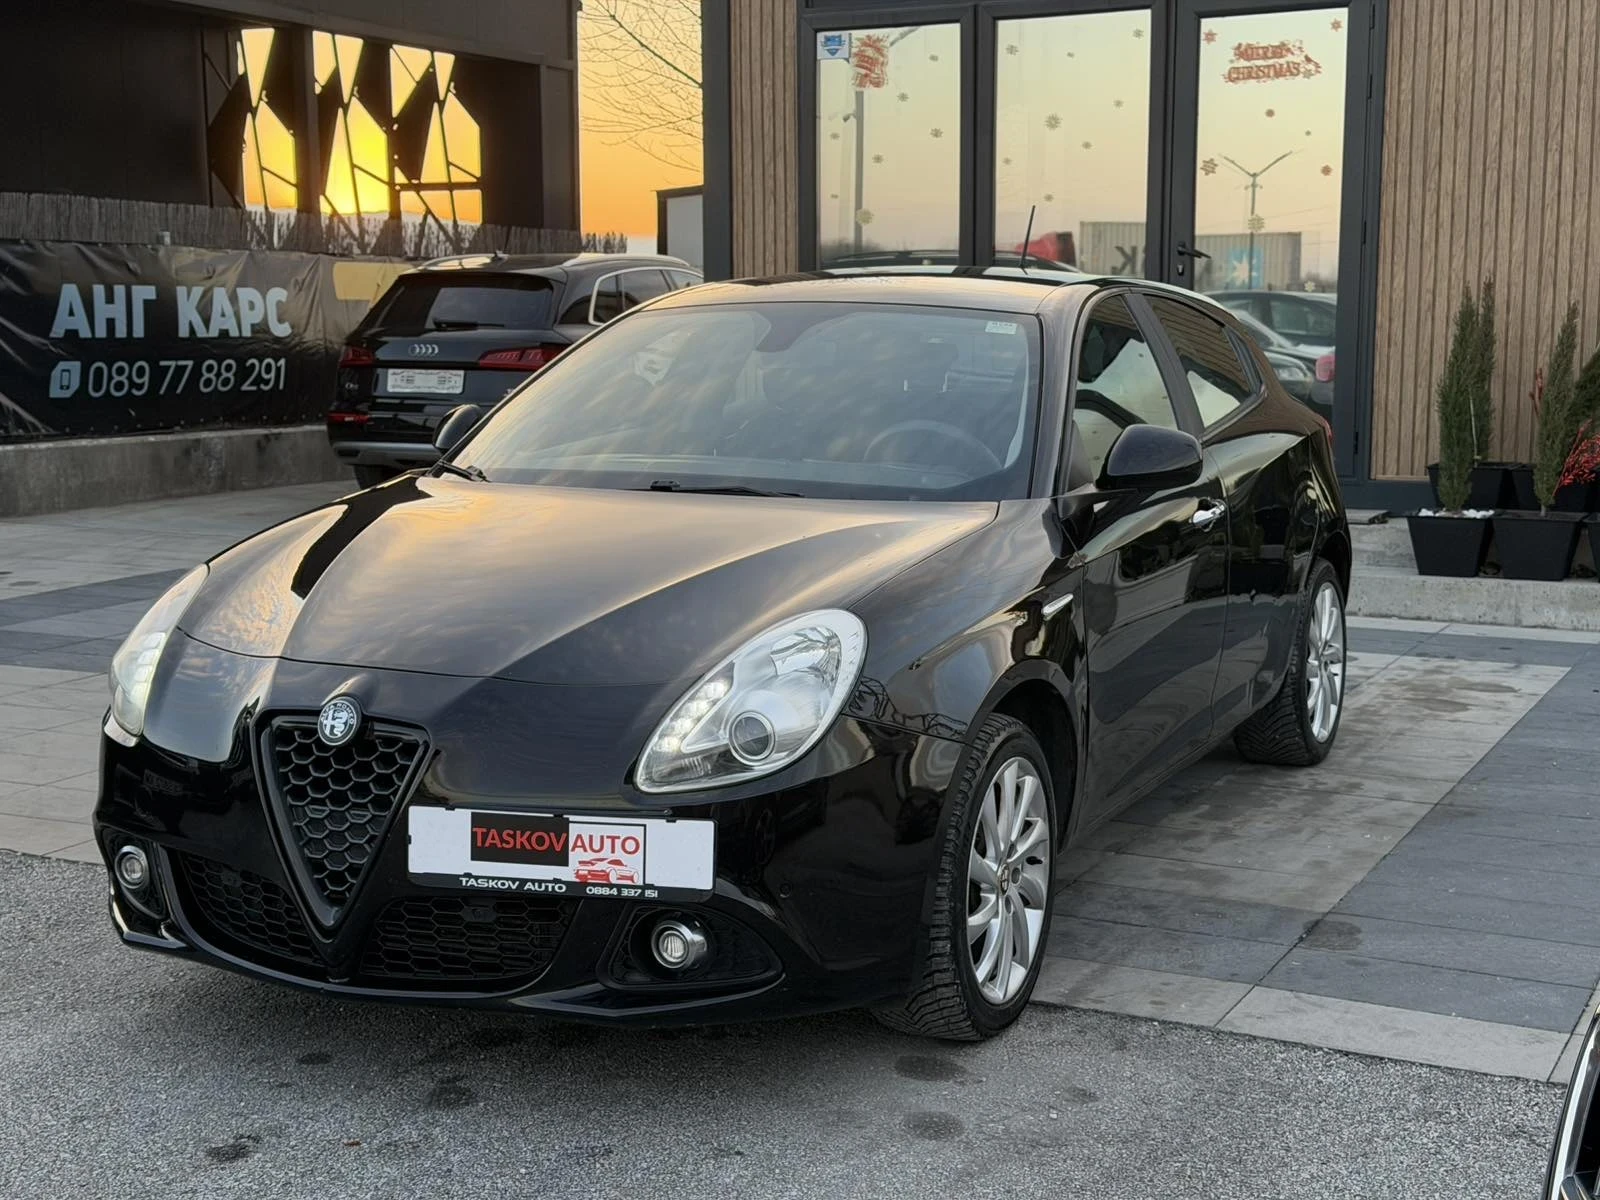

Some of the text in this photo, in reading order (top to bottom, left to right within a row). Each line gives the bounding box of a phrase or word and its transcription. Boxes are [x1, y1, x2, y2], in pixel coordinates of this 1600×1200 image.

[1228, 62, 1301, 83] CHRISTMAS
[50, 283, 292, 338] АНГ КАРС
[88, 358, 286, 397] 089 77 88 291
[472, 827, 641, 855] TASKOV AUTO
[459, 877, 520, 890] TASKOV
[524, 881, 567, 893] AUTO
[586, 886, 618, 896] 0884
[621, 888, 642, 898] 337
